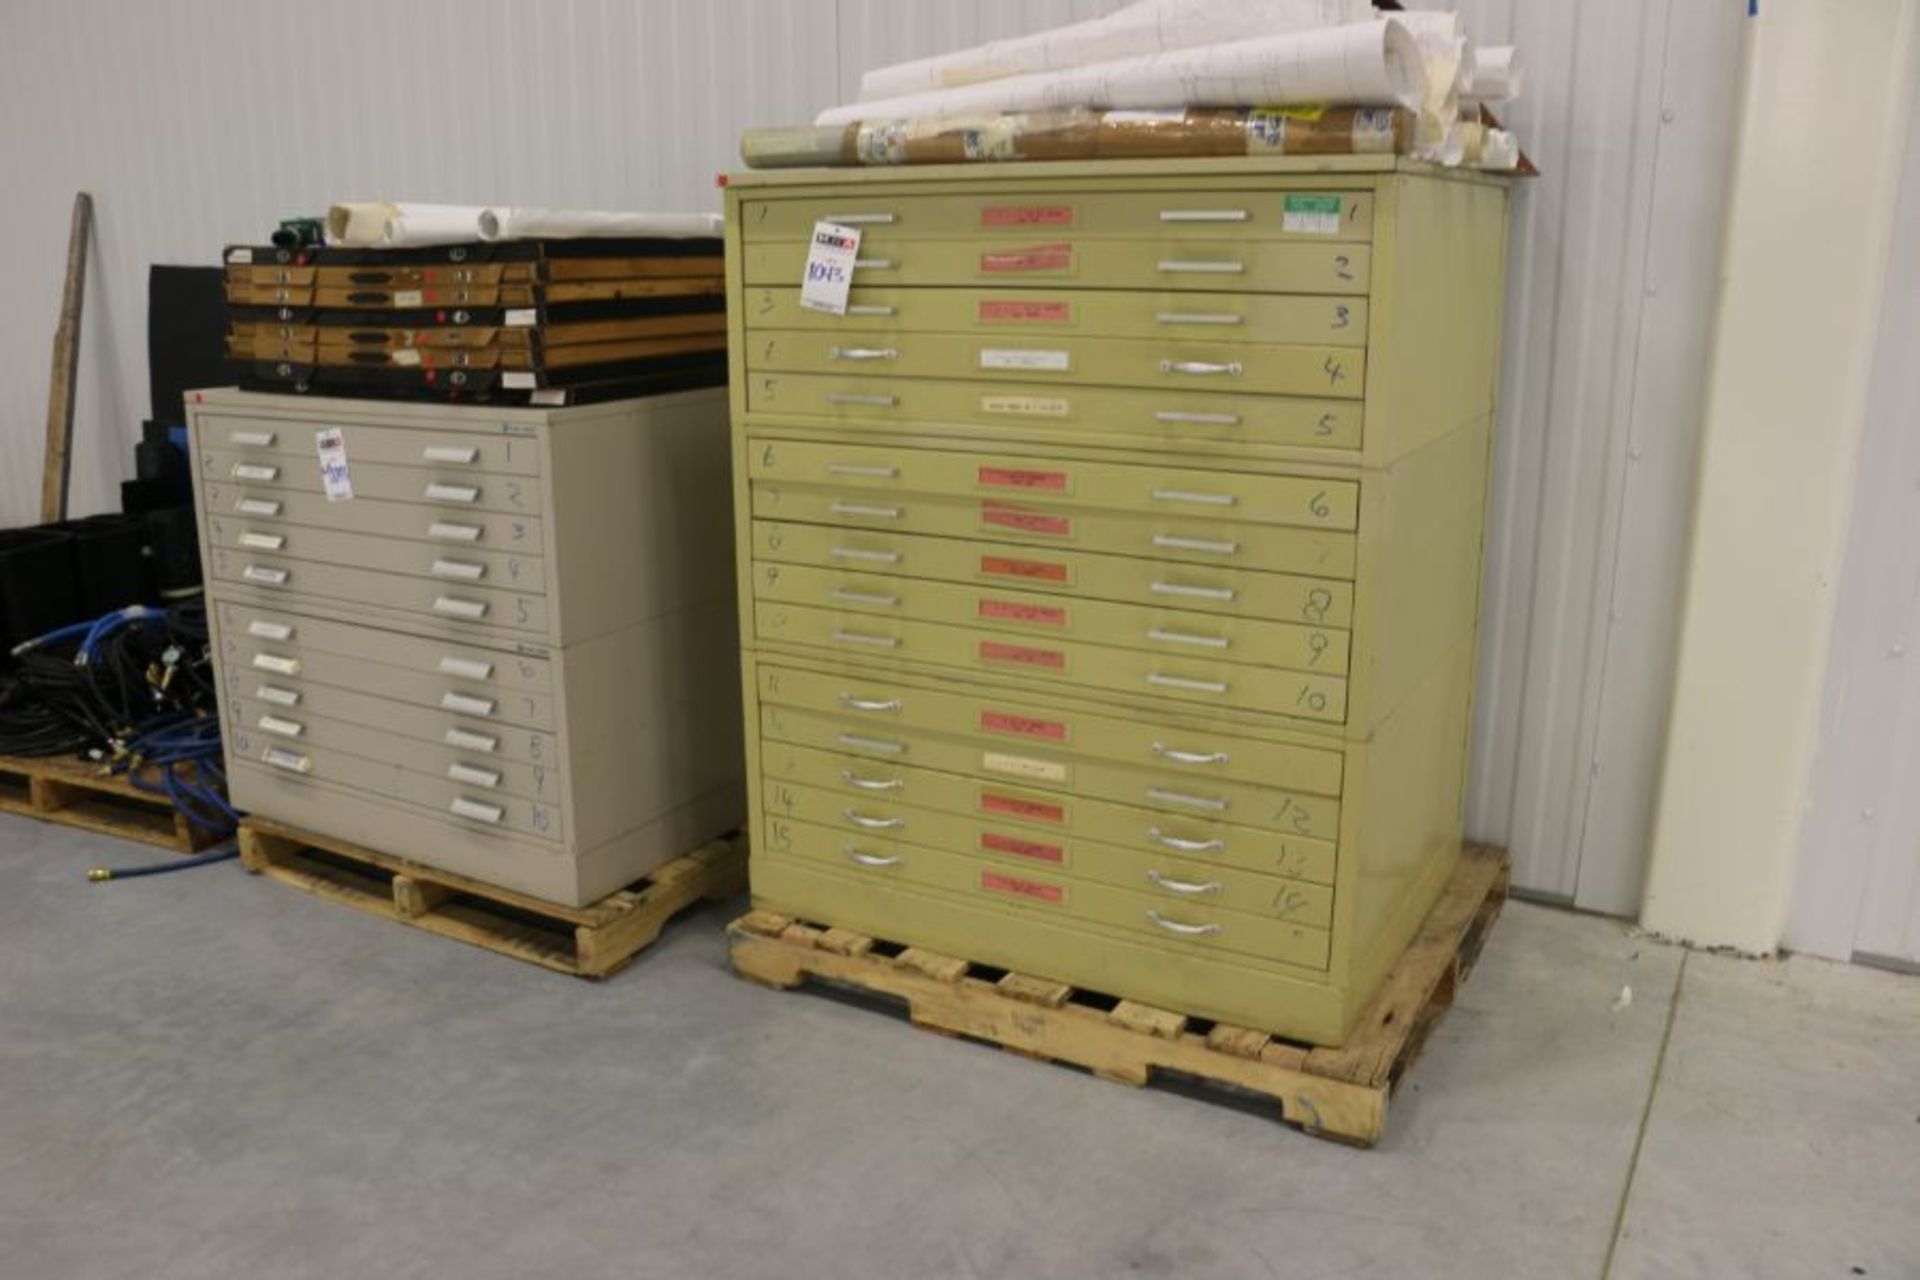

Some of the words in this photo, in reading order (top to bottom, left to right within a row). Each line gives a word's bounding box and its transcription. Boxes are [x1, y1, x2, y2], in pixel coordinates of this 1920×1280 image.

[1348, 203, 1359, 223] 1
[1335, 255, 1354, 281] 2
[1331, 305, 1350, 329] 3
[1323, 355, 1344, 386] 4
[1315, 413, 1336, 437] 5
[1309, 490, 1330, 519] 6
[1302, 587, 1332, 623] 8
[1308, 632, 1329, 667] 9
[1296, 684, 1327, 712] 10
